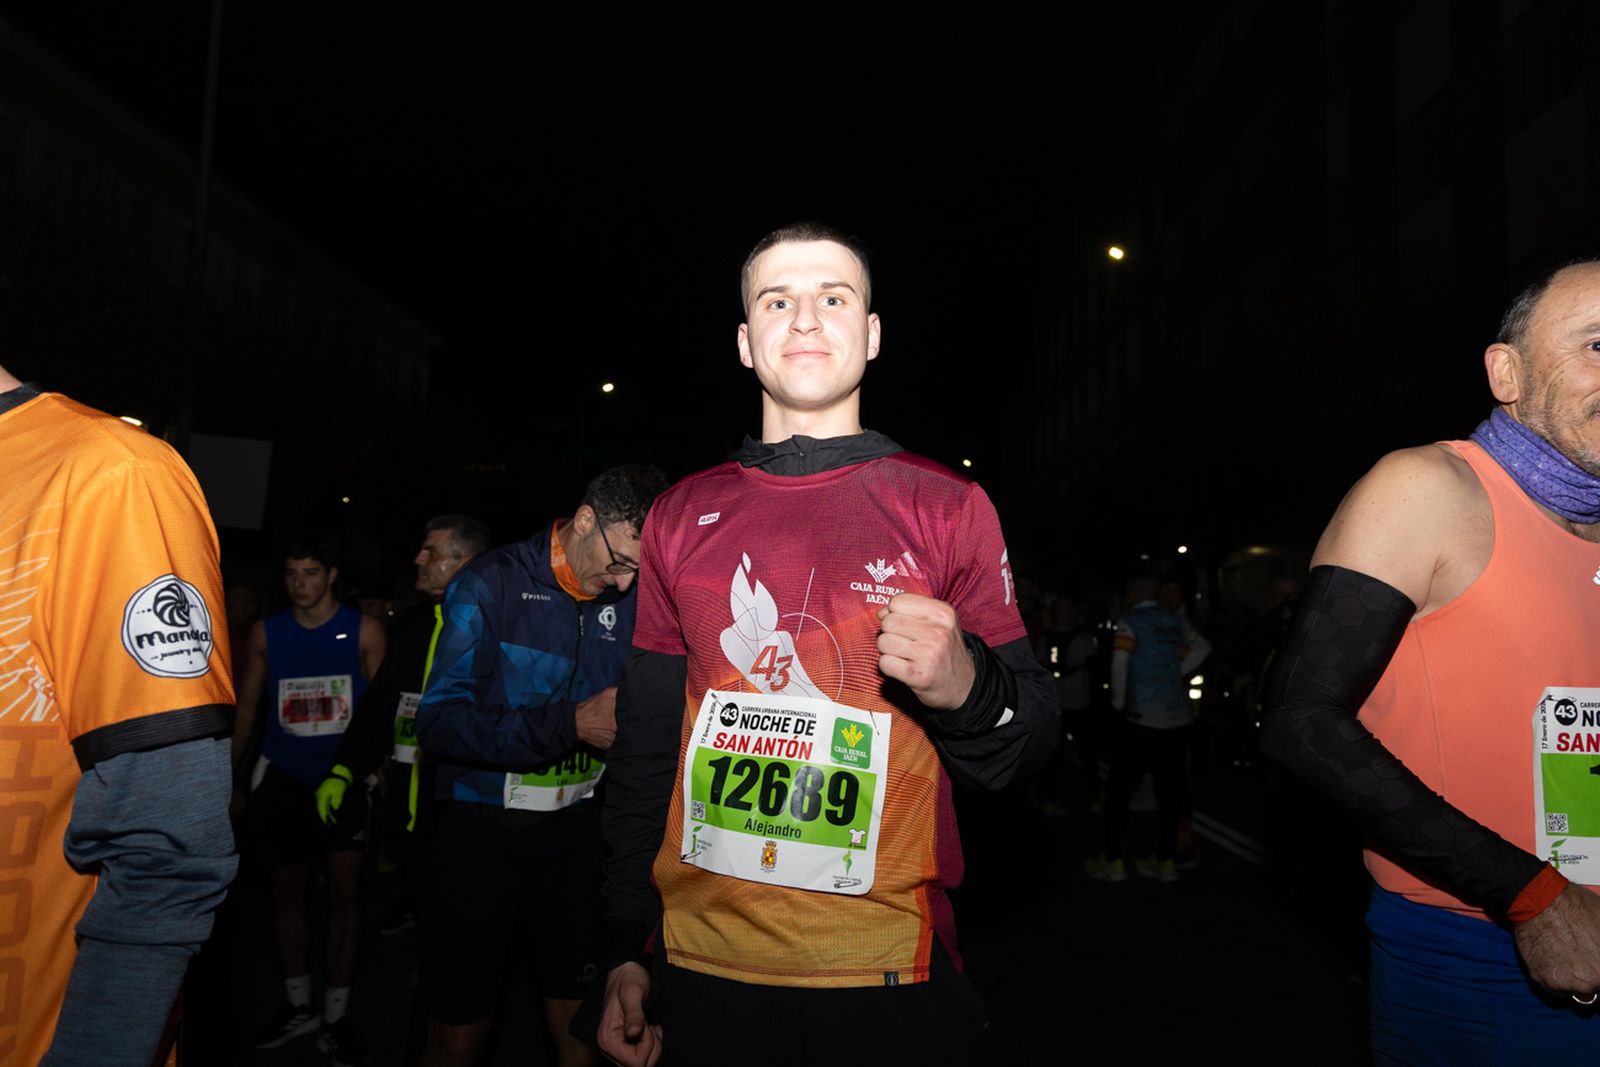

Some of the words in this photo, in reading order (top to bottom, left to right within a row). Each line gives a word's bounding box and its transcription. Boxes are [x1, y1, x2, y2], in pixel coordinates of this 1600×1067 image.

[875, 585, 904, 596] RURA
[750, 645, 794, 692] 43
[720, 708, 738, 720] 43
[780, 709, 817, 719] INTERNACIONAL
[1556, 705, 1576, 719] 43
[739, 713, 791, 733] NOCHE
[793, 718, 816, 736] DE
[713, 732, 751, 753] SAN
[752, 735, 813, 760] ANTÓN
[1557, 732, 1600, 752] SAN
[708, 756, 859, 826] 12689
[744, 818, 802, 838] Alejandro
